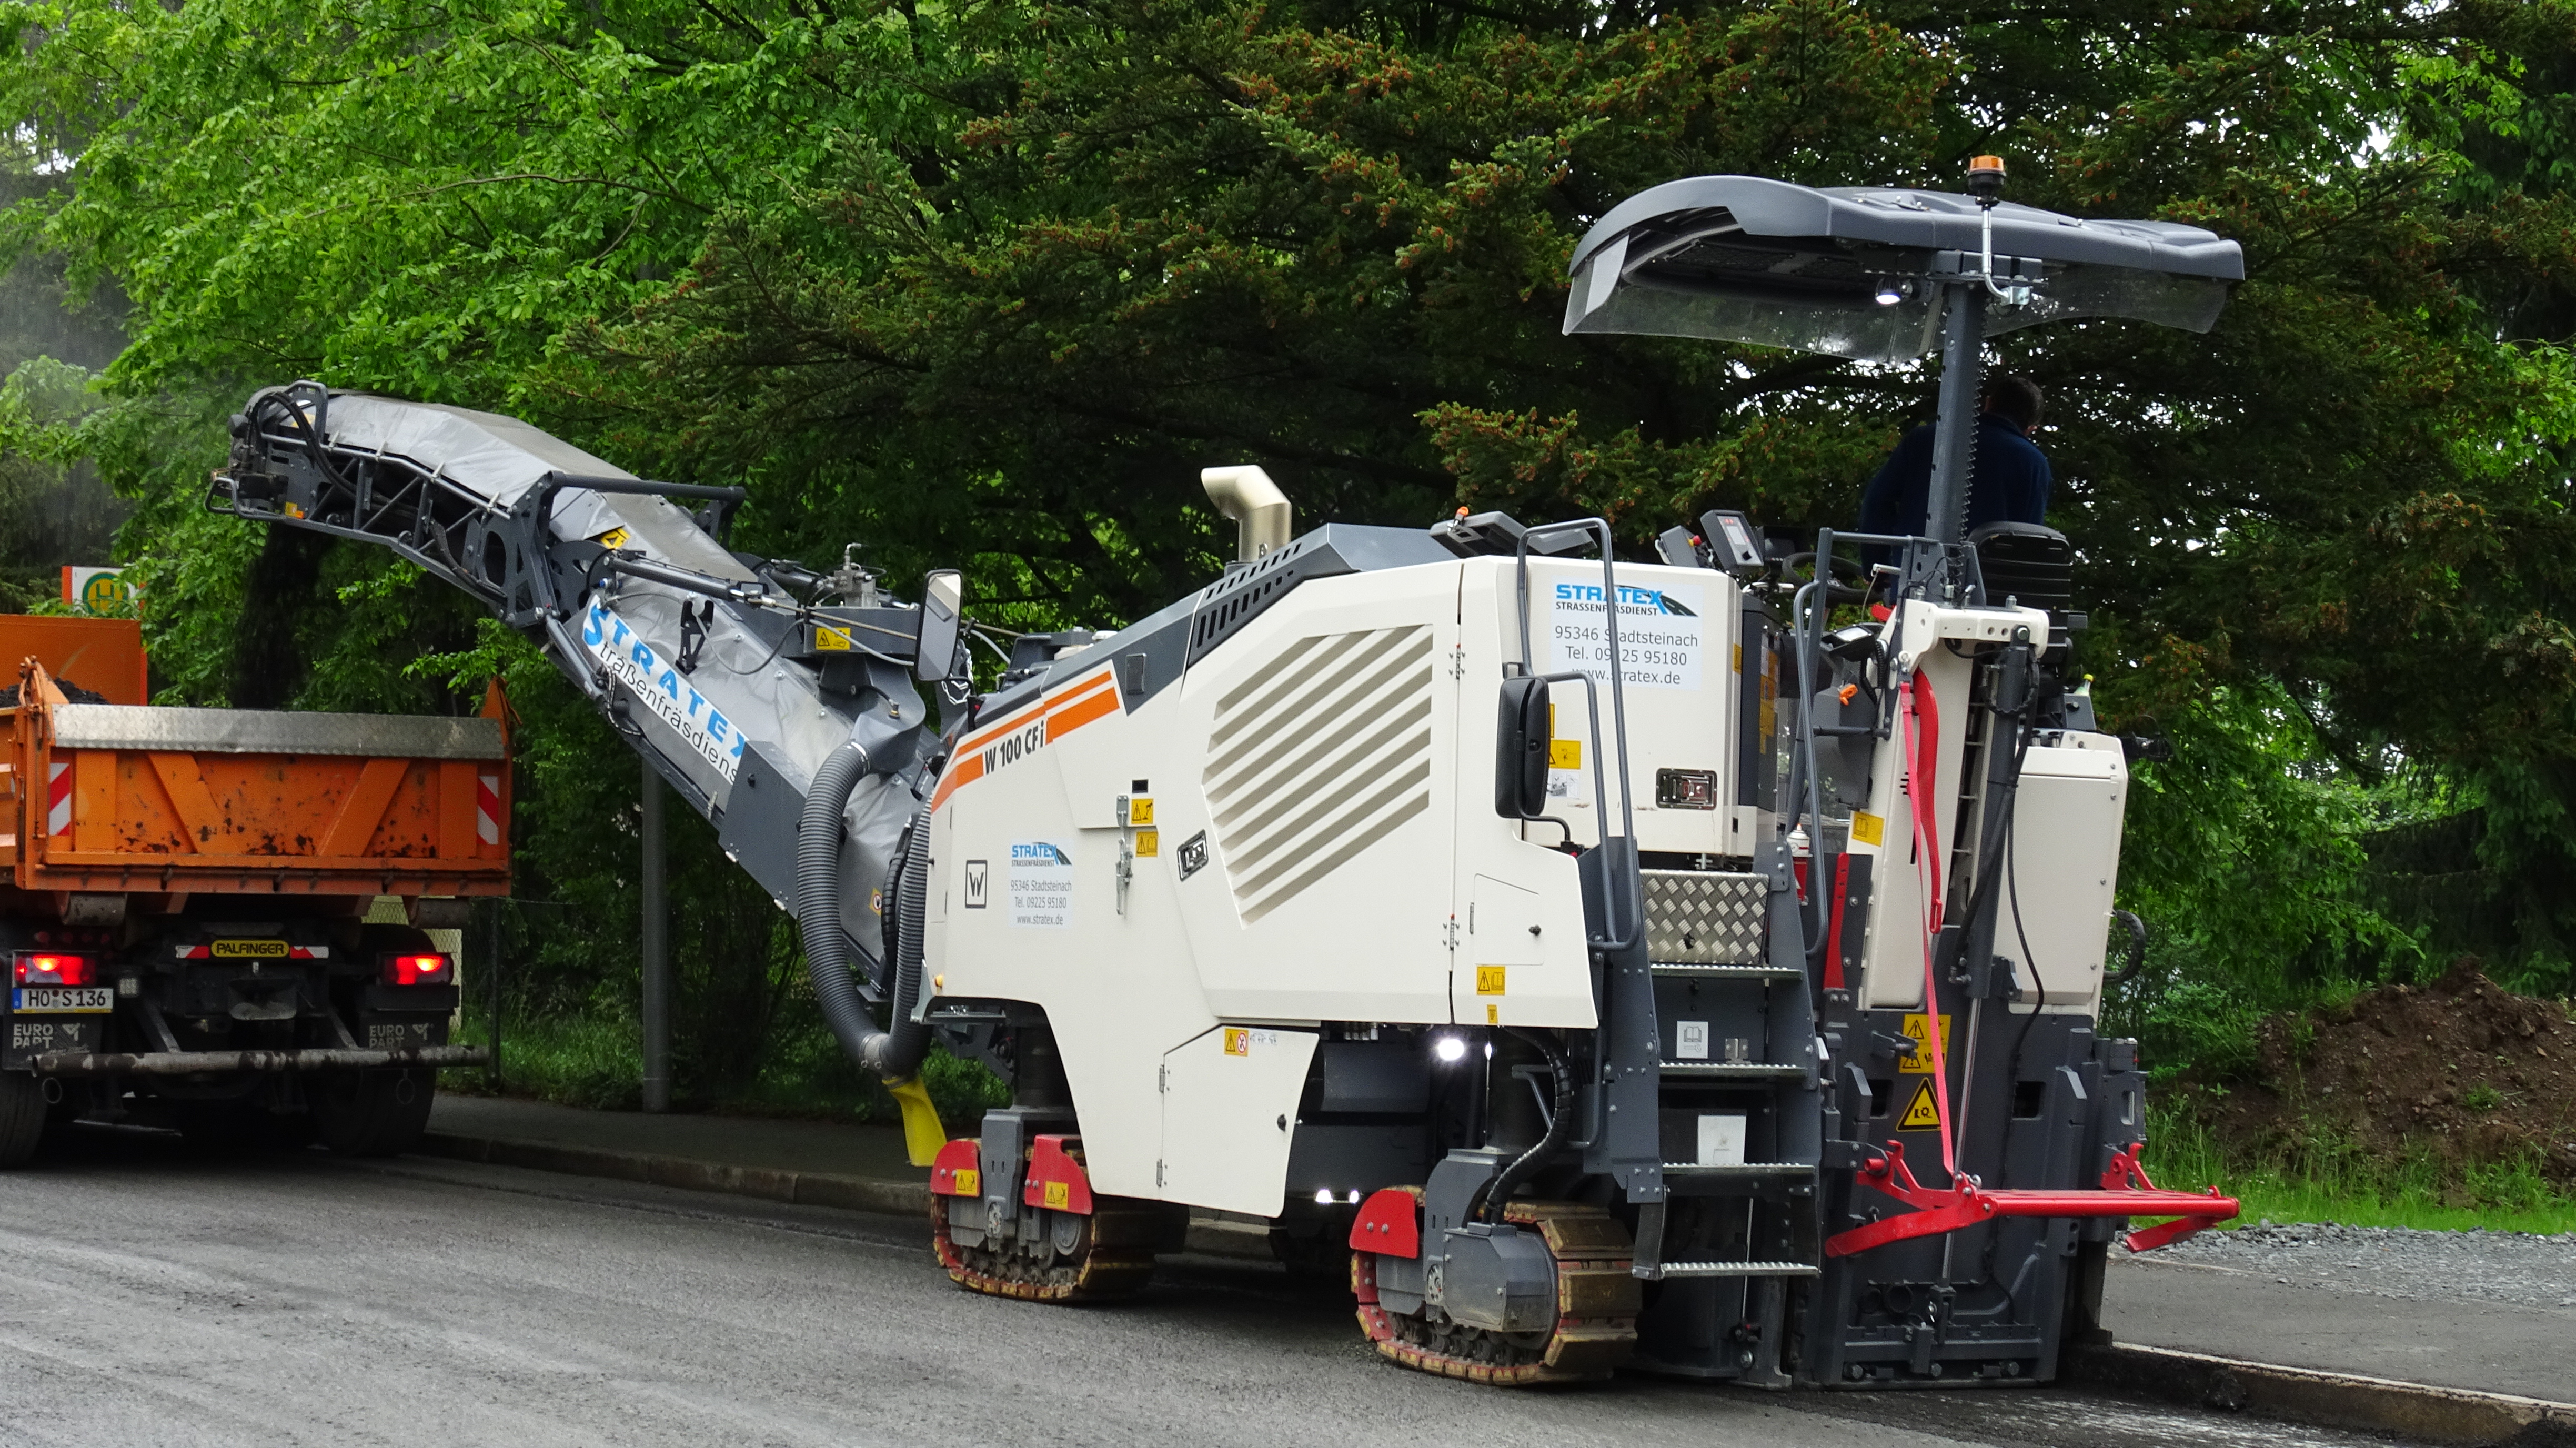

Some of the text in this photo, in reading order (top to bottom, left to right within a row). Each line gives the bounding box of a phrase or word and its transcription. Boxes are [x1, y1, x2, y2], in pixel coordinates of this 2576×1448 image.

[1556, 602, 1658, 616] STRASSENFÄSDIENST
[1555, 625, 1698, 647] 95346 Sadtsteinach
[1565, 646, 1687, 666] Tel. 0925 95180
[985, 720, 1044, 775] W 100 CFi
[1012, 844, 1059, 865] STRATEX
[969, 872, 984, 897] W
[1011, 880, 1072, 892] 95346 Stadtsteinach
[1015, 897, 1066, 908] Tel. 09225 95180
[1017, 914, 1063, 926] www.stratex.de
[216, 943, 284, 954] PALFINGER
[29, 991, 106, 1007] HO S 136
[13, 1023, 54, 1037] EURO
[369, 1024, 405, 1037] EURO
